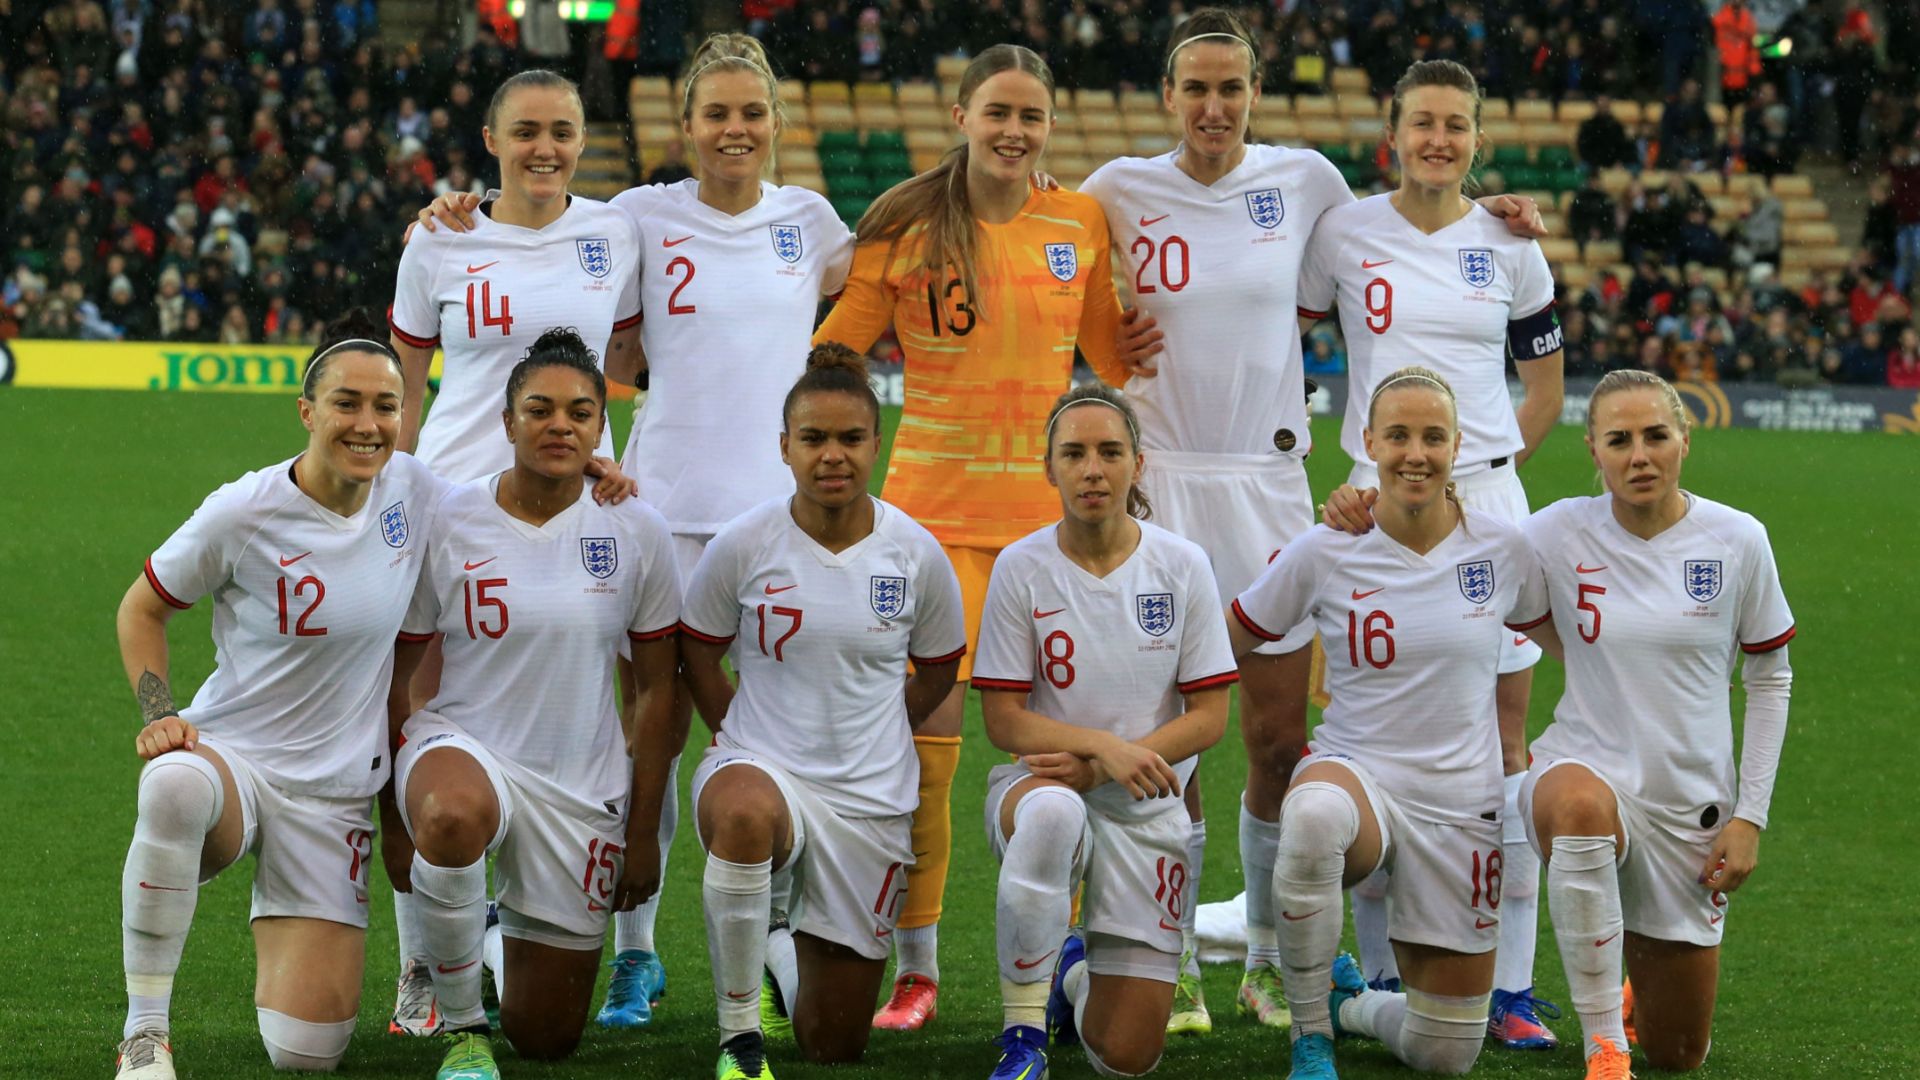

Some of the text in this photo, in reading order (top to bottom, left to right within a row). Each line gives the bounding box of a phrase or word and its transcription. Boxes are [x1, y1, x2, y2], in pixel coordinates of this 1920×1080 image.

[667, 257, 695, 314] 2
[1129, 236, 1189, 294] 20
[466, 282, 512, 338] 14
[928, 278, 976, 336] 13
[1366, 278, 1392, 334] 9
[1532, 325, 1564, 356] CAP
[278, 576, 327, 636] 12
[465, 579, 509, 640] 15
[757, 604, 803, 662] 17
[1578, 584, 1605, 643] 5
[1037, 631, 1076, 689] 18
[1349, 611, 1395, 670] 16
[584, 837, 622, 898] 15
[1155, 857, 1186, 921] 18
[1472, 850, 1502, 910] 16
